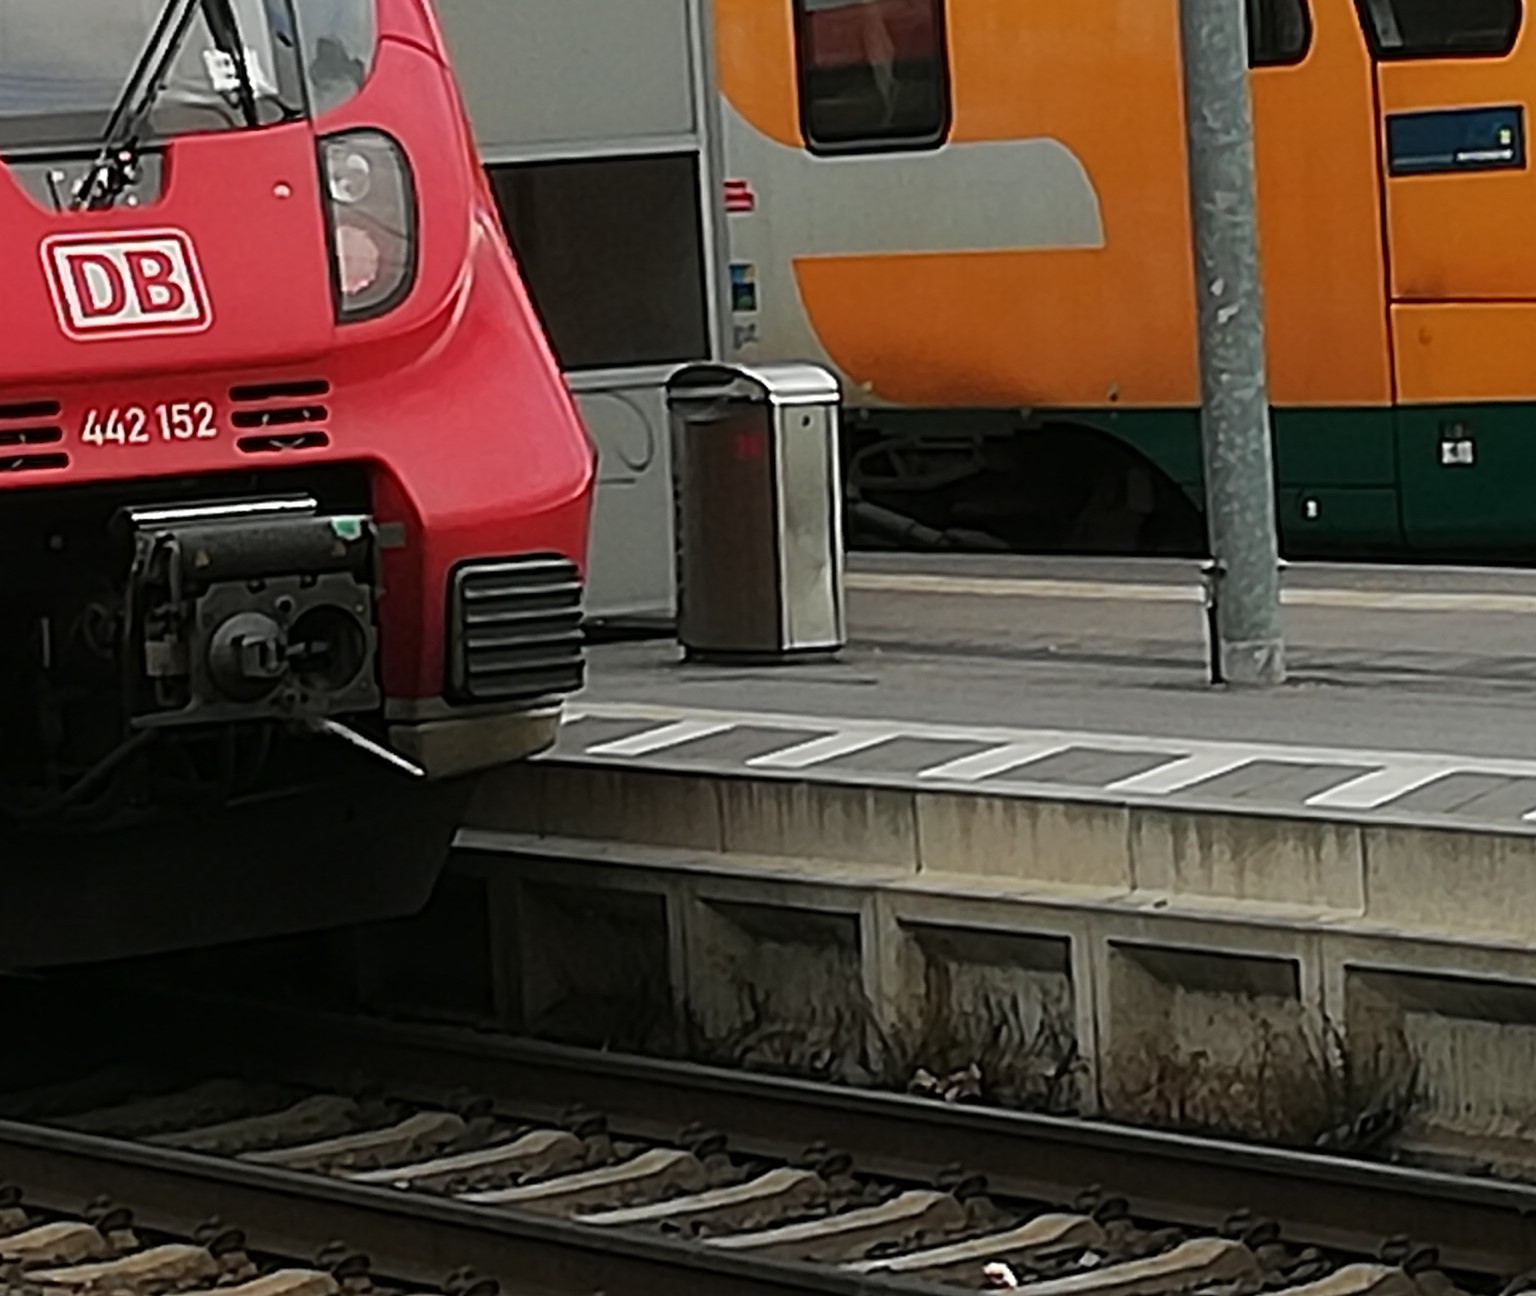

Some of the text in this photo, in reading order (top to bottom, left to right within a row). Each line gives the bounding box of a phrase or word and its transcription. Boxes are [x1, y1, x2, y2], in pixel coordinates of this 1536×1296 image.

[68, 249, 185, 317] DB
[81, 401, 217, 446] 442 152
